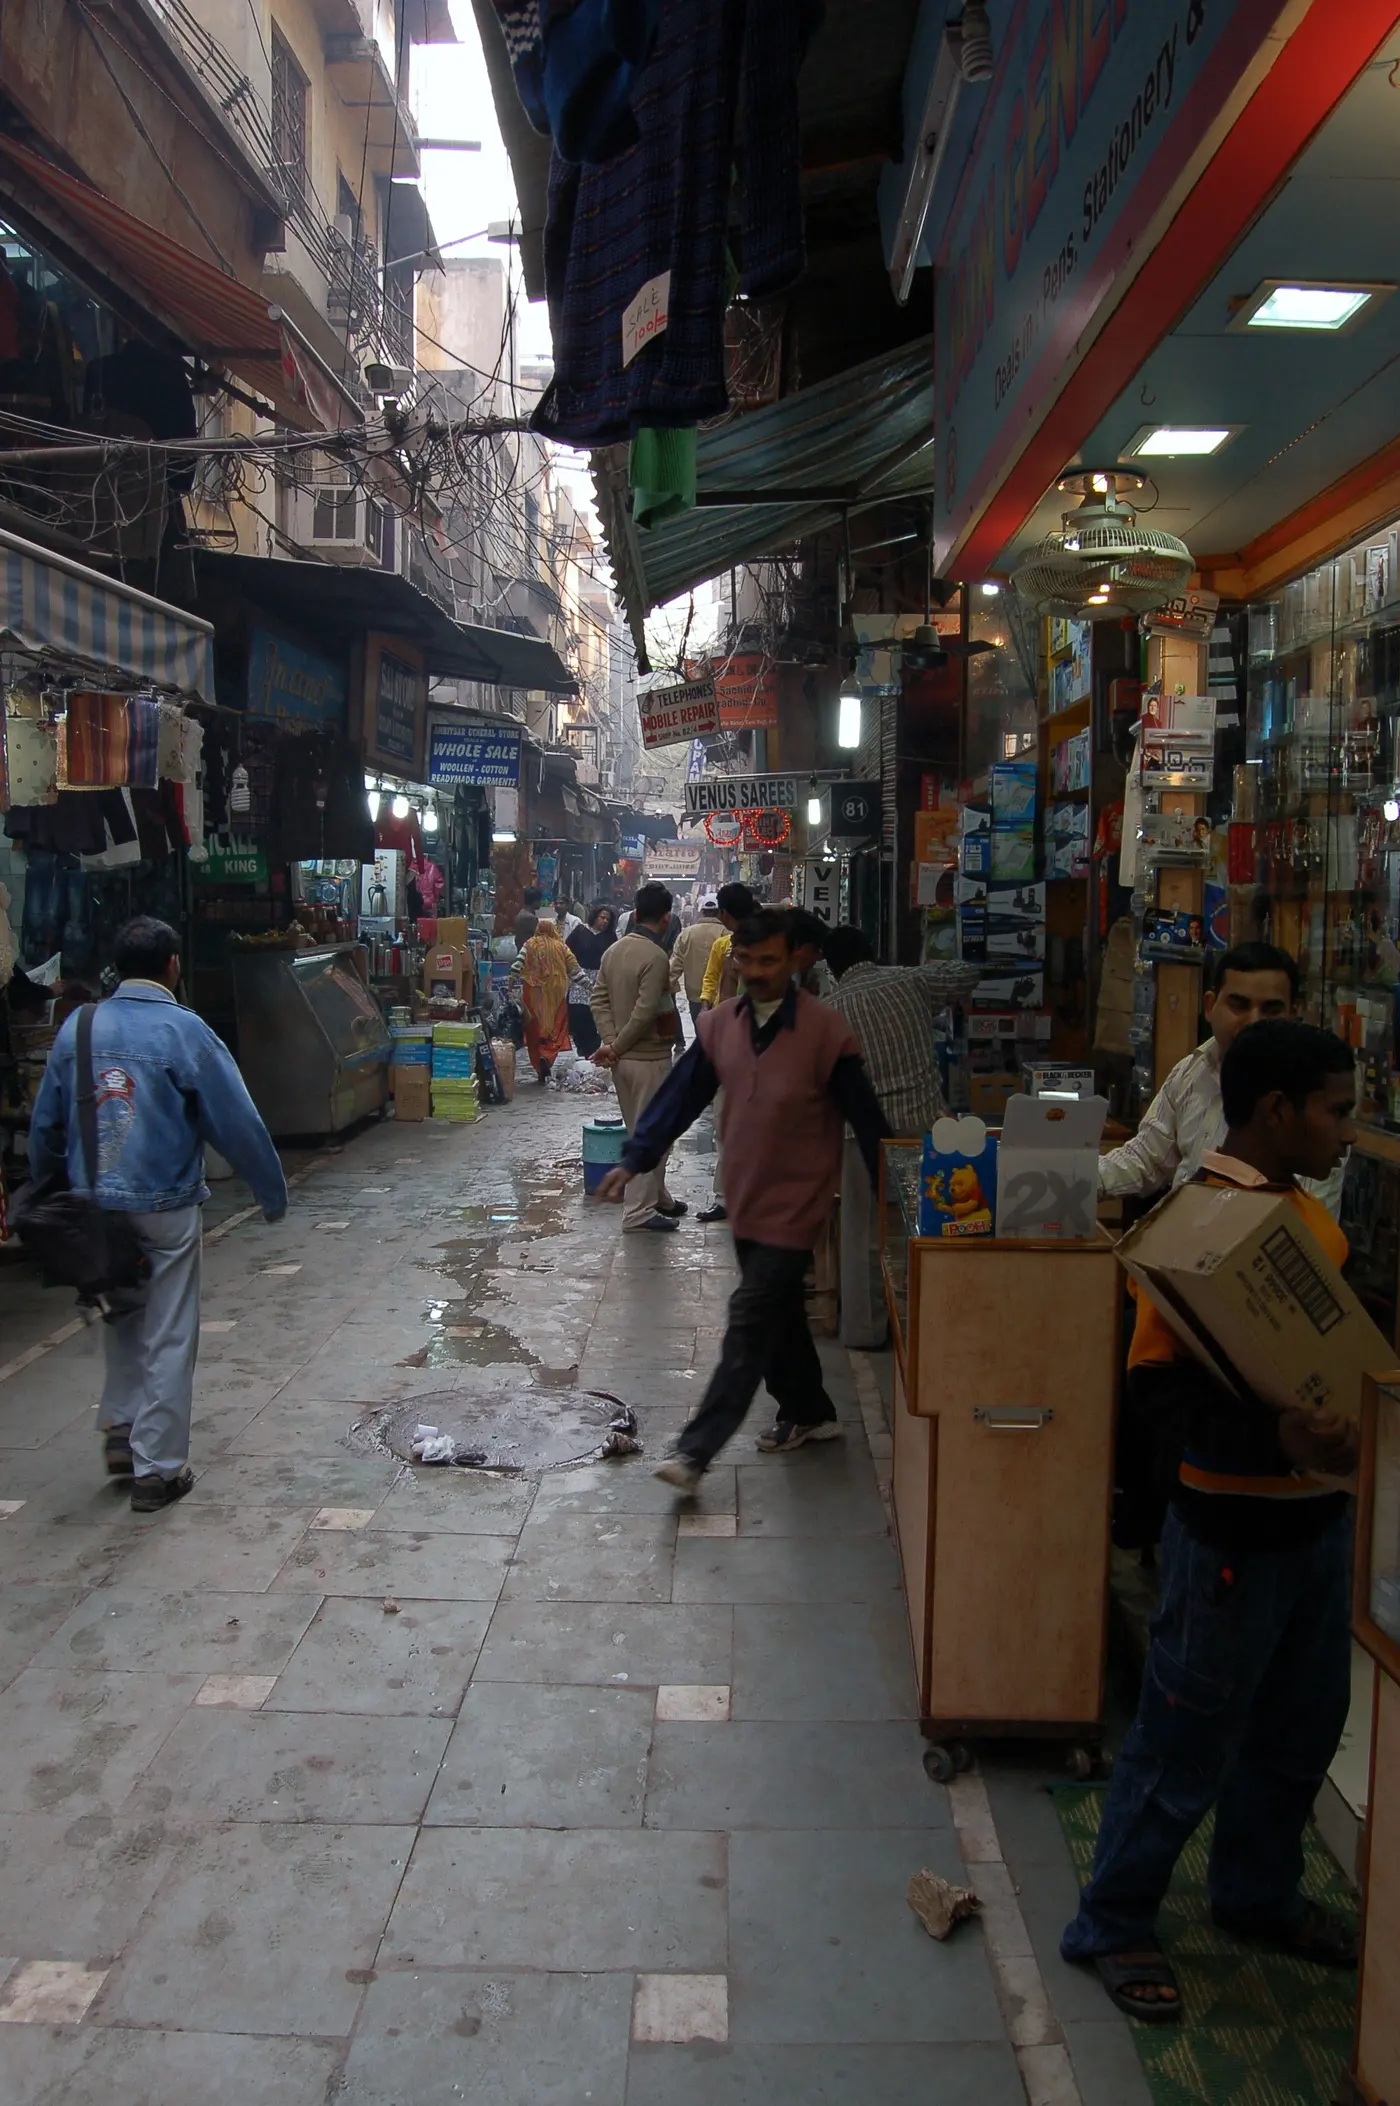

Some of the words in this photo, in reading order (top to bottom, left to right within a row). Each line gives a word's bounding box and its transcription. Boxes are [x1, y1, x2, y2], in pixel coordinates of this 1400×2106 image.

[995, 337, 1020, 412] Deals
[1083, 22, 1178, 242] Stationery
[627, 287, 661, 337] SALE
[657, 682, 714, 708] TELEPHONES
[642, 709, 679, 731] MOBILE
[680, 701, 717, 725] REPAIR
[468, 727, 496, 738] GENERAL
[498, 729, 519, 739] STORE
[433, 742, 482, 758] WHOLE
[484, 745, 518, 760] SALE
[439, 762, 475, 773] WOOLLEN
[481, 764, 509, 775] COTTON
[431, 773, 476, 785] READYMADE
[476, 776, 516, 787] GARMENTS
[688, 783, 736, 811] VENUS
[741, 780, 795, 808] SAREES
[845, 802, 865, 817] 81
[224, 858, 257, 873] KING
[1002, 1170, 1092, 1236] 2X
[948, 1221, 986, 1237] POOH
